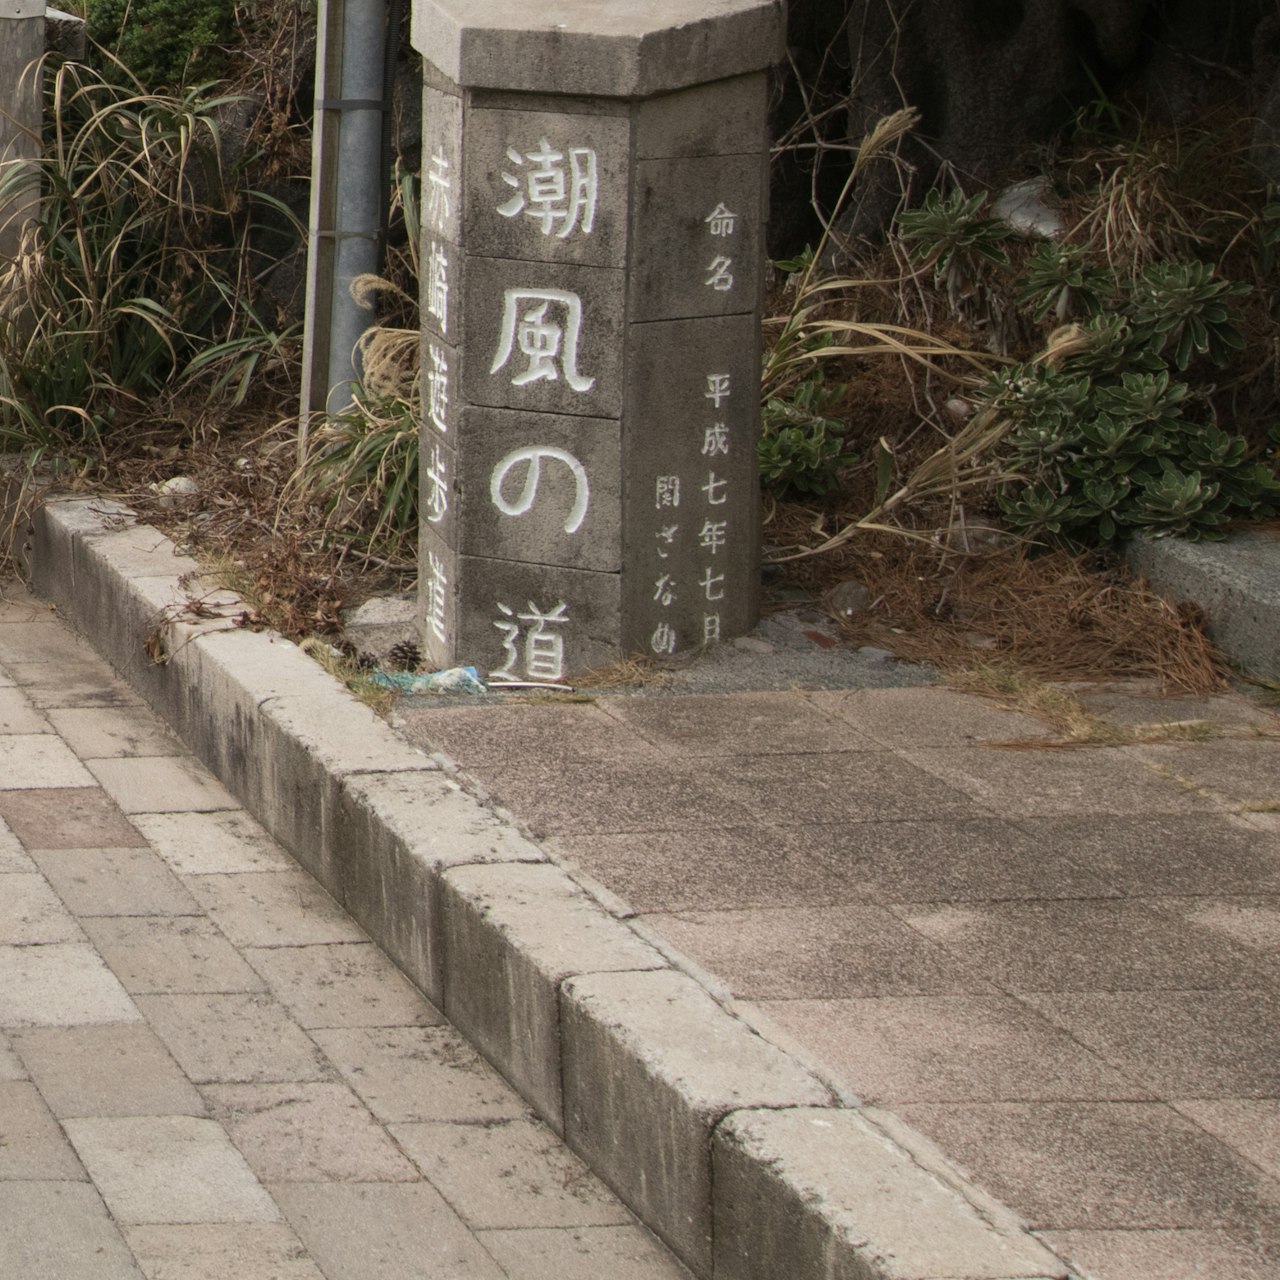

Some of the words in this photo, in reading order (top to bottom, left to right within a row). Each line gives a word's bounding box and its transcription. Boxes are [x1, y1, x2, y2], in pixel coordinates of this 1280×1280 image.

[705, 201, 738, 291] 命名
[489, 137, 597, 689] 潮風の道
[699, 373, 730, 645] 平成七年七月
